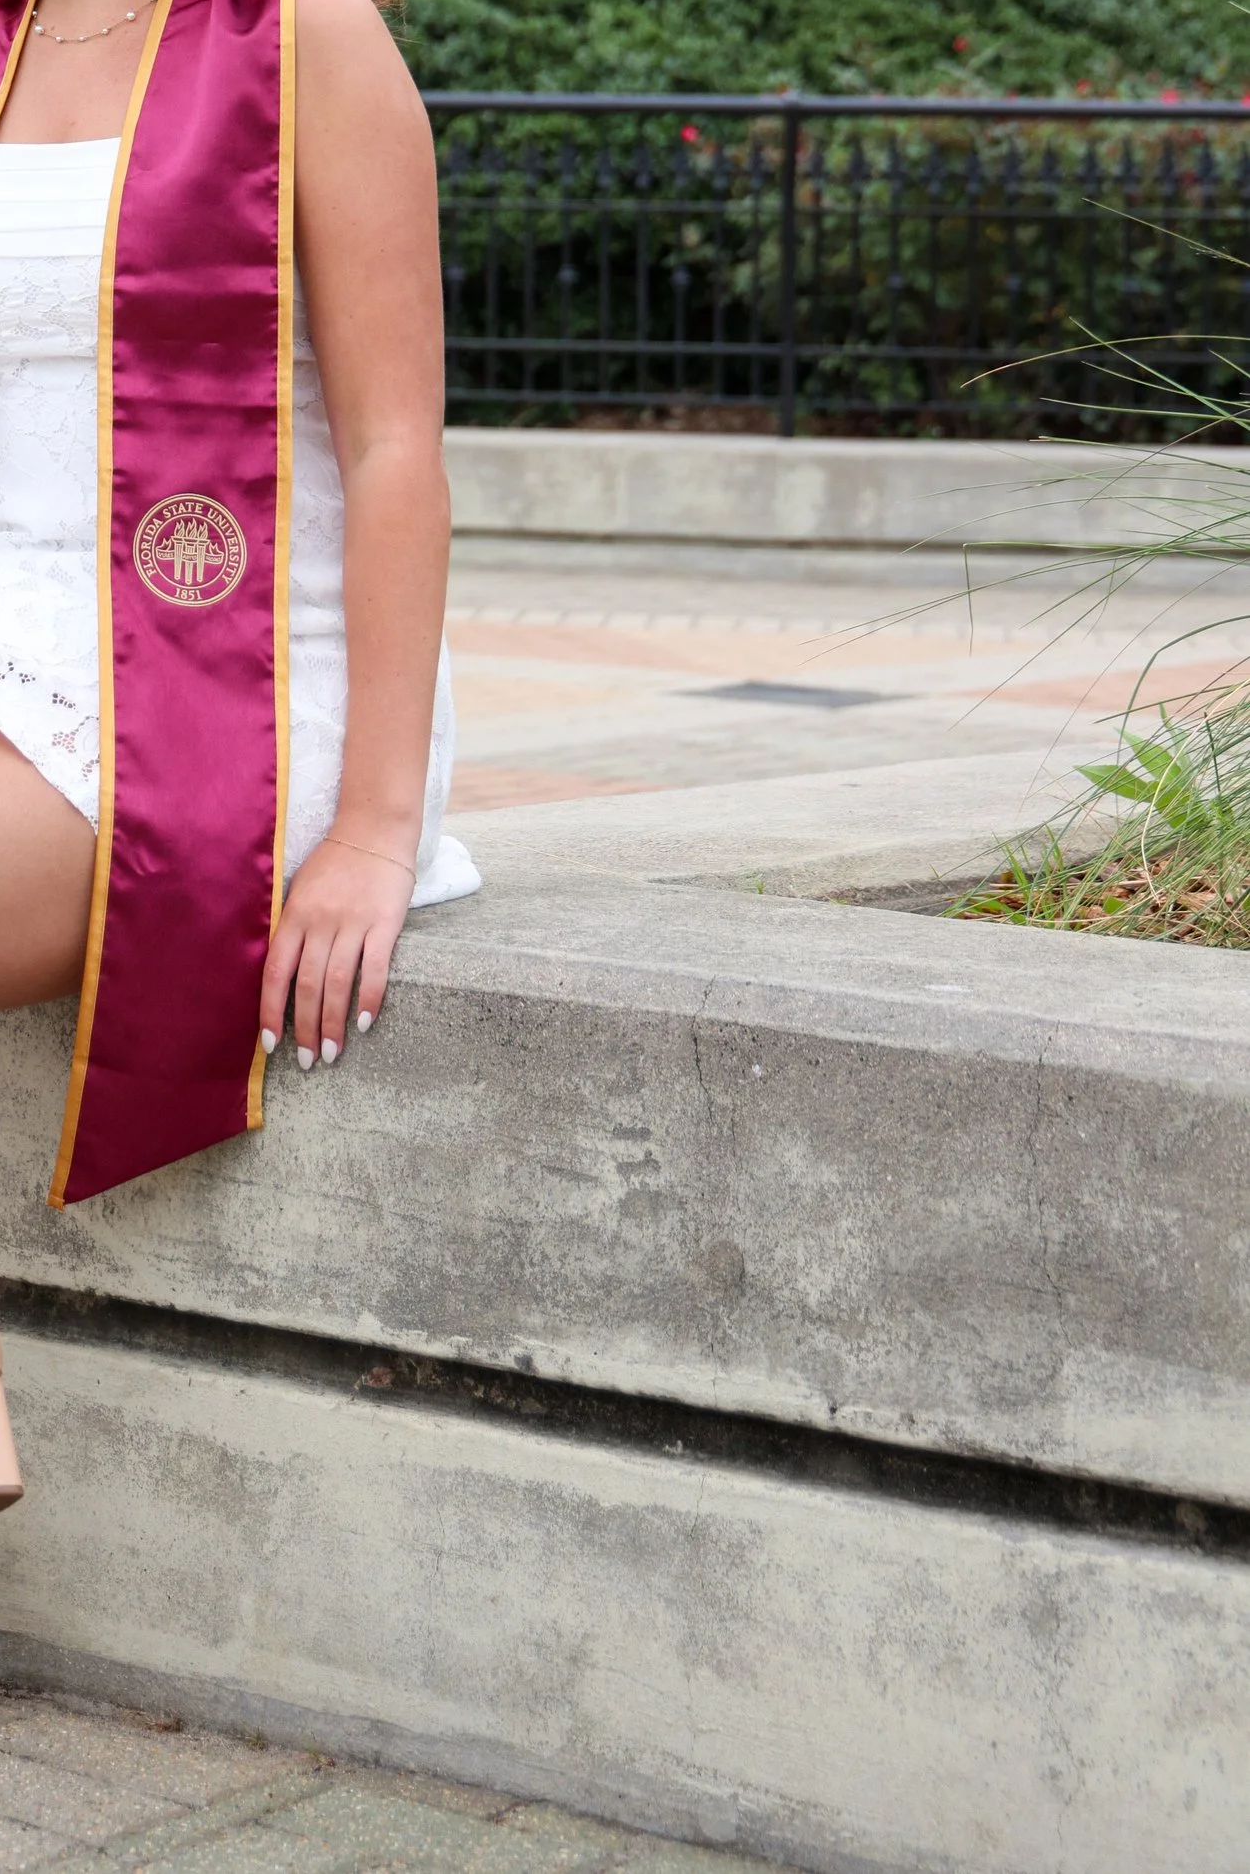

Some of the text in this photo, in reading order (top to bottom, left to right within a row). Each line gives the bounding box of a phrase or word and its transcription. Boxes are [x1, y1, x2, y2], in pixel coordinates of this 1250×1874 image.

[141, 502, 239, 585] FLORIDA STATE UNIVERSITY
[174, 588, 203, 601] 1851
